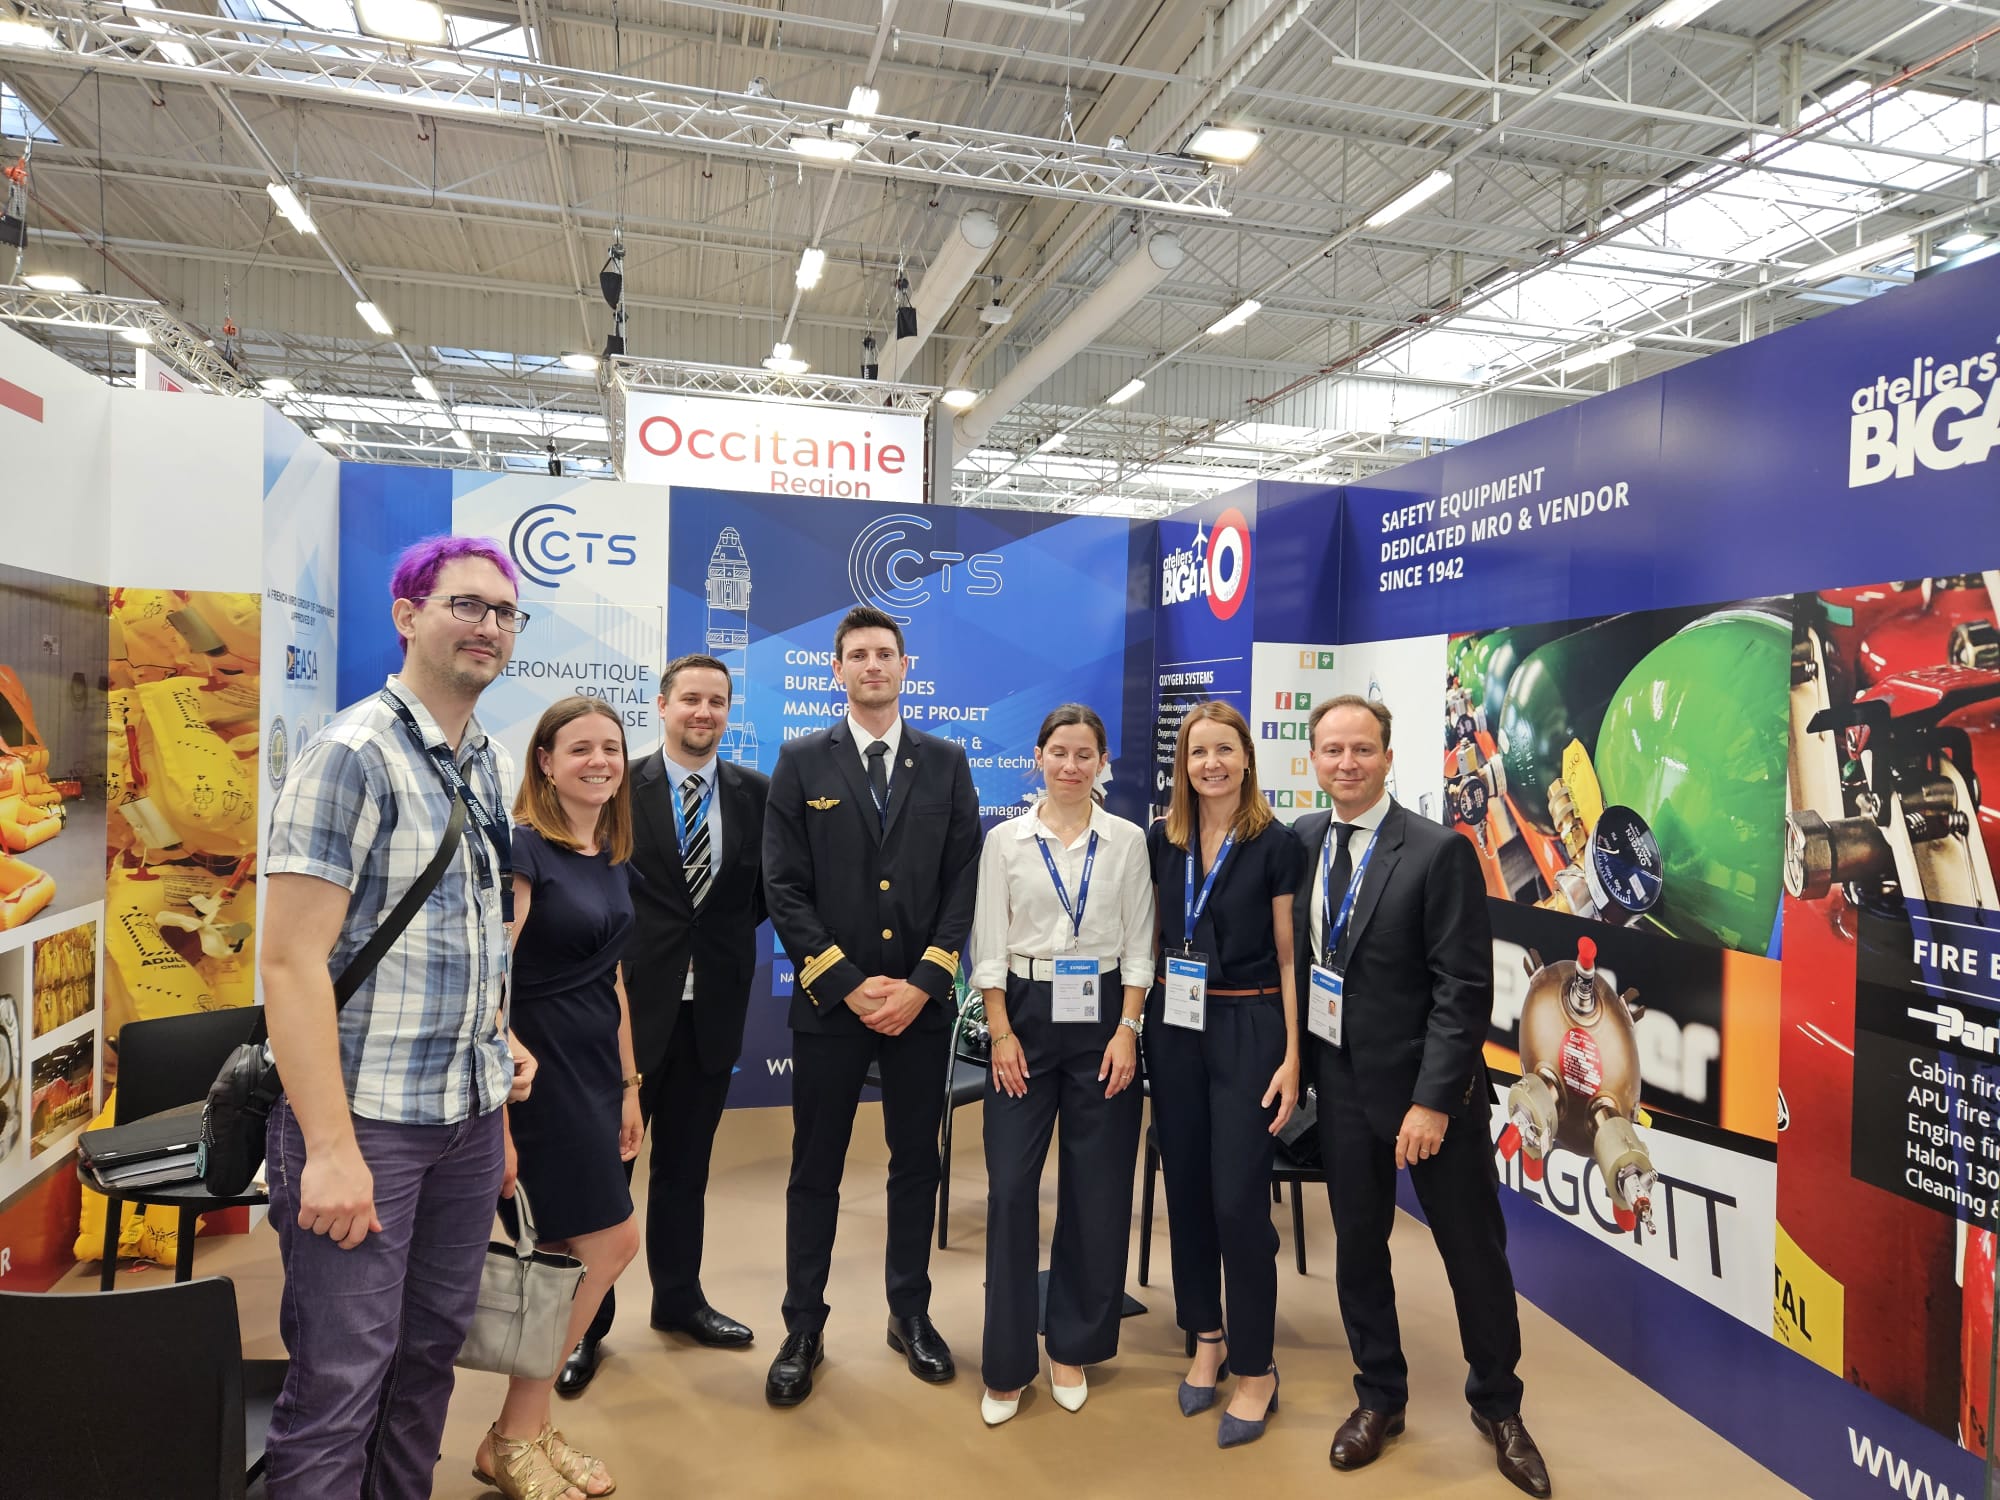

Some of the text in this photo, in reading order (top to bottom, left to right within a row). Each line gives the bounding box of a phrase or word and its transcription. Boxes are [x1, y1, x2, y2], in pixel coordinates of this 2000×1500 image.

[1851, 352, 1998, 414] ateliers
[639, 415, 905, 474] Occitanie
[770, 470, 871, 499] Region
[1381, 467, 1545, 533] SAFETY EQUIPMENT
[1381, 481, 1630, 563] DEDICATED MRO & VENDOR
[1163, 547, 1193, 570] ateliers
[1379, 557, 1464, 592] SINCE 1942
[295, 648, 318, 681] EASA
[1159, 671, 1214, 687] OXYGEN SYSTEMS
[575, 686, 650, 705] SPATIAL
[903, 705, 924, 720] DE
[928, 706, 989, 721] PROJET
[783, 726, 827, 741] ING
[972, 737, 983, 750] &
[998, 755, 1038, 769] techn
[1625, 828, 1646, 866] OXYGEN
[1914, 939, 1978, 976] FIRE
[1492, 938, 1721, 1103] Per
[1909, 1057, 1966, 1091] Cabin
[1907, 1085, 1949, 1114] APU
[1955, 1098, 1990, 1128] fire
[1908, 1112, 1975, 1153] Engine
[1906, 1140, 2000, 1190] Halon 130
[1905, 1168, 1986, 1218] Cleaning
[0, 1247, 11, 1277] R
